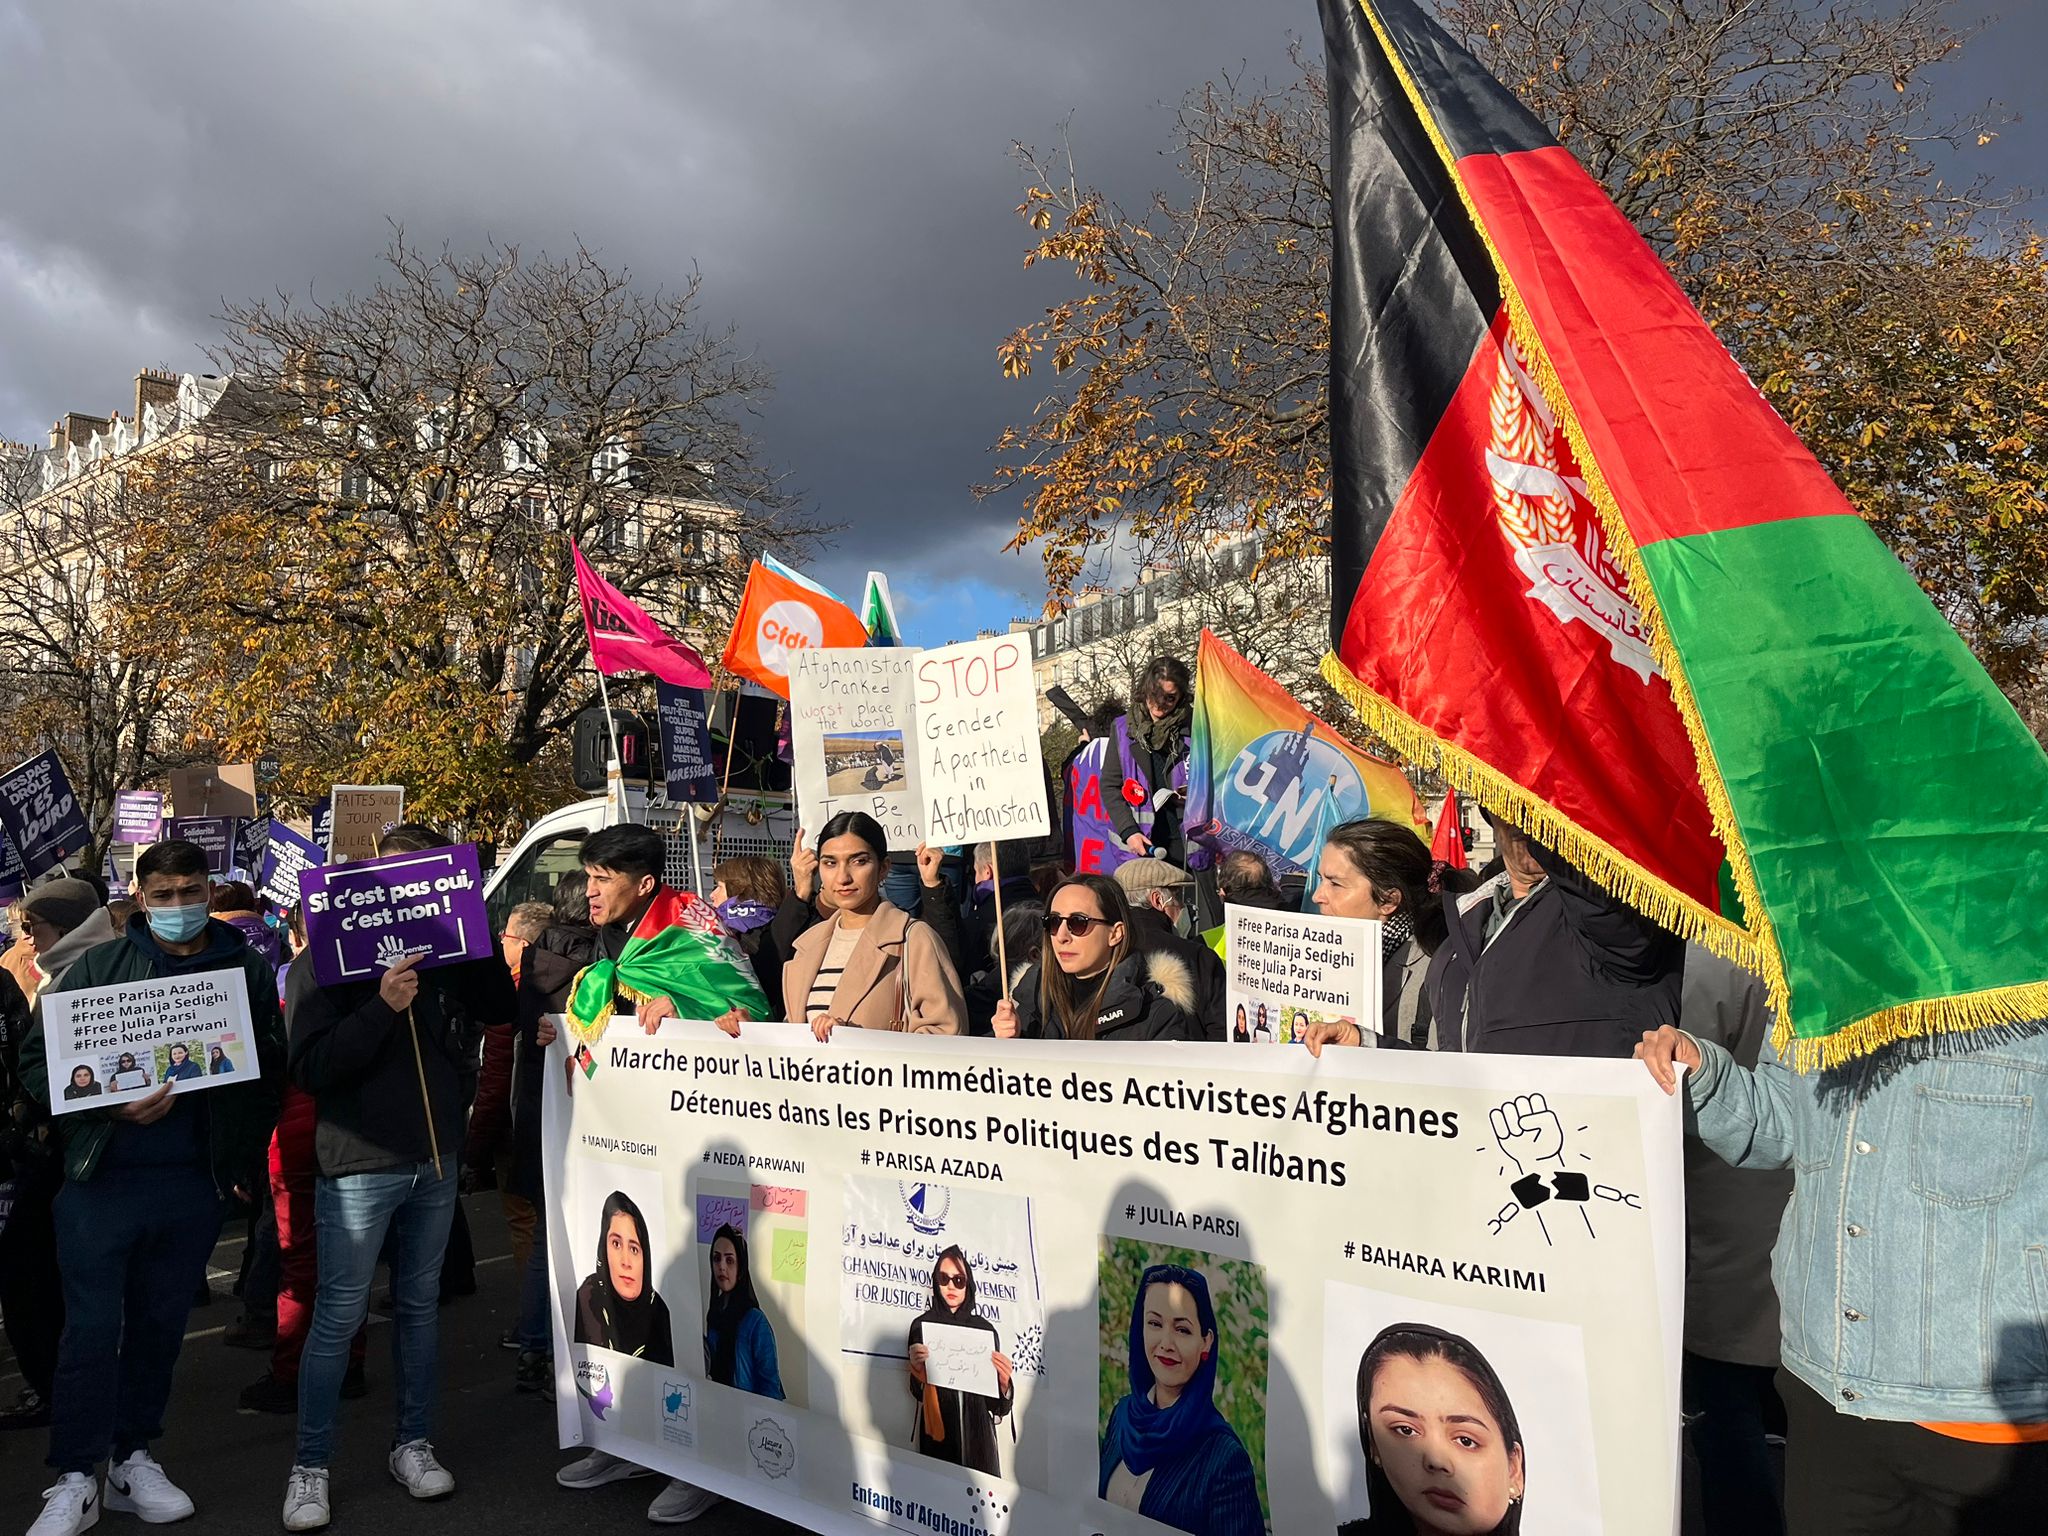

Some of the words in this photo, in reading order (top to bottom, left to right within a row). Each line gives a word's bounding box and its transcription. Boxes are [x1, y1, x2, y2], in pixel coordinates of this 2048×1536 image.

[762, 619, 814, 648] Cfdt
[798, 652, 914, 689] Afghanistan
[918, 644, 1019, 704] STOP
[830, 679, 890, 695] ranked
[800, 702, 845, 720] worst
[857, 701, 893, 720] place
[905, 703, 916, 714] in
[817, 715, 837, 731] the
[850, 714, 895, 728] world
[925, 708, 1004, 740] Gender
[675, 726, 695, 736] SUPER
[261, 761, 278, 770] BUS
[666, 763, 714, 782] AGRESSEUR
[932, 735, 1028, 783] Apartheid
[0, 774, 26, 797] T'ES
[25, 760, 51, 781] PAS
[969, 775, 986, 791] in
[20, 785, 54, 826] T'ES
[336, 793, 376, 807] FAITES
[872, 796, 903, 818] Be
[20, 793, 73, 851] LOURD
[346, 812, 382, 824] JOUIR
[931, 793, 1043, 840] Afghanistan
[333, 836, 345, 847] AU
[257, 886, 297, 908] AGRESS
[309, 891, 330, 914] Si
[334, 885, 386, 910] c'est
[389, 880, 432, 905] pas
[434, 868, 475, 892] oui,
[341, 908, 394, 932] c'est
[396, 901, 440, 922] non
[442, 895, 452, 914] !
[1237, 917, 1262, 934] #Free
[1265, 921, 1299, 939] Parisa
[1302, 927, 1343, 945] Azada
[377, 943, 433, 959] #25novembre
[1237, 936, 1261, 952] #Free
[1263, 940, 1301, 962] Manija
[1304, 947, 1355, 969] Sedighi
[1237, 953, 1261, 971] #Free
[1261, 960, 1286, 976] Julia
[1290, 963, 1322, 982] Parsi
[71, 995, 114, 1010] #Free
[119, 988, 165, 1005] Parisa
[169, 980, 214, 996] Azada
[1237, 972, 1260, 989] #Free
[1261, 977, 1290, 996] Neda
[1293, 983, 1350, 1006] Parwani
[71, 1008, 115, 1024] #Free
[119, 1000, 170, 1020] Manija
[174, 991, 228, 1009] Sedighi
[1097, 1010, 1124, 1025] PAJAR
[73, 1022, 117, 1038] #Free
[120, 1016, 155, 1033] Julia
[159, 1009, 197, 1024] Parsi
[73, 1036, 118, 1051] #Free
[122, 1030, 162, 1044] Neda
[166, 1018, 228, 1036] Parwani
[610, 1046, 688, 1072] Marche
[694, 1054, 740, 1080] pour
[745, 1053, 764, 1078] la
[768, 1056, 893, 1087] Libération
[902, 1063, 1052, 1098] Immédiate
[1061, 1072, 1113, 1104] des
[1122, 1077, 1287, 1120] Activistes
[1292, 1090, 1460, 1139] Afghanes
[587, 1134, 620, 1152] MANIJA
[621, 1140, 658, 1157] SEDIGHI
[670, 1089, 772, 1121] Détenues
[779, 1098, 831, 1127] dans
[837, 1103, 871, 1131] les
[878, 1108, 977, 1141] Prisons
[986, 1116, 1133, 1160] Politiques
[1143, 1130, 1200, 1166] des
[1208, 1137, 1348, 1188] Talibans
[703, 1150, 711, 1163] #
[713, 1150, 746, 1168] NEDA
[749, 1155, 805, 1174] PARWANI
[861, 1149, 871, 1165] #
[875, 1150, 936, 1174] PARISA
[940, 1157, 1004, 1182] AZADA
[1125, 1204, 1136, 1220] #
[1138, 1206, 1187, 1229] JULIA
[1192, 1213, 1240, 1238] PARSI
[868, 1232, 899, 1248] عدالت
[902, 1239, 925, 1257] برای
[1344, 1241, 1356, 1259] #
[1361, 1244, 1446, 1278] BAHARA
[1452, 1261, 1546, 1293] KARIMI
[855, 1284, 878, 1301] FOR
[881, 1287, 923, 1308] JUSTICE
[976, 1281, 1017, 1300] VEMENT
[852, 1483, 902, 1520] Enfants
